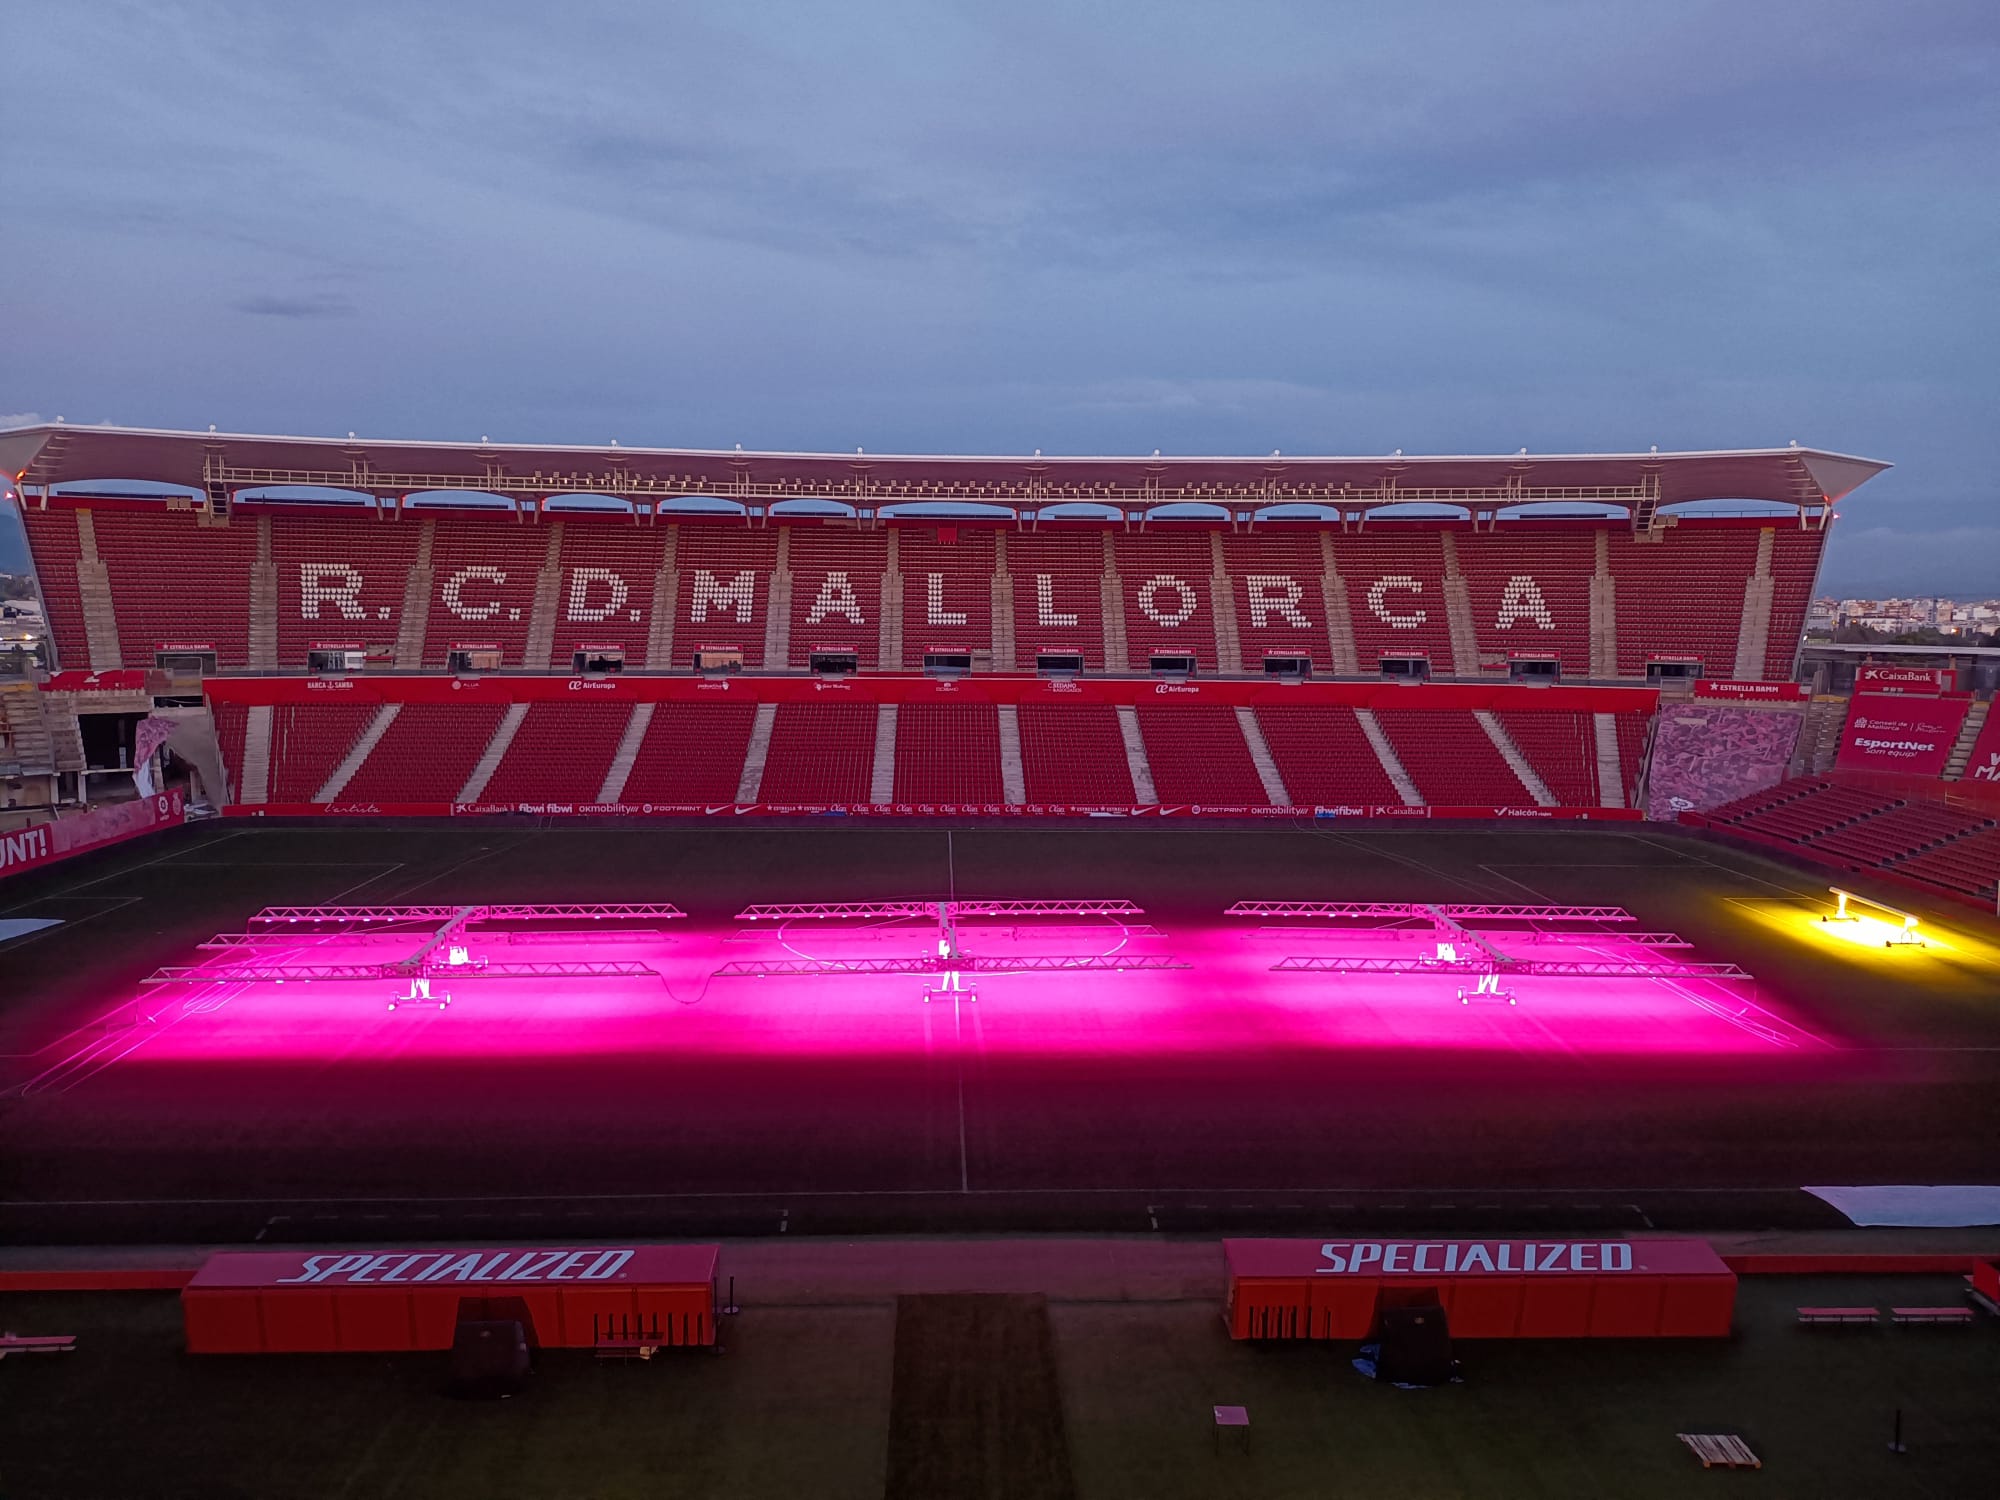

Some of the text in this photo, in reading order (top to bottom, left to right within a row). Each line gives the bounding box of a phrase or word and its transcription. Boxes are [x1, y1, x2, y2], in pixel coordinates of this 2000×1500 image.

[690, 570, 1556, 629] MALLORCA
[1879, 670, 1931, 682] CaixaBank
[1720, 684, 1754, 692] ESTRELLA
[1854, 737, 1935, 752] EsportNet
[1864, 747, 1886, 755] Som
[519, 803, 572, 813] fibwi fibwi
[1339, 806, 1363, 815] fibwi
[1387, 806, 1424, 815] CaixaBank
[1316, 1243, 1632, 1273] SPECIALIZED
[276, 1250, 634, 1283] SPECIALIZED
